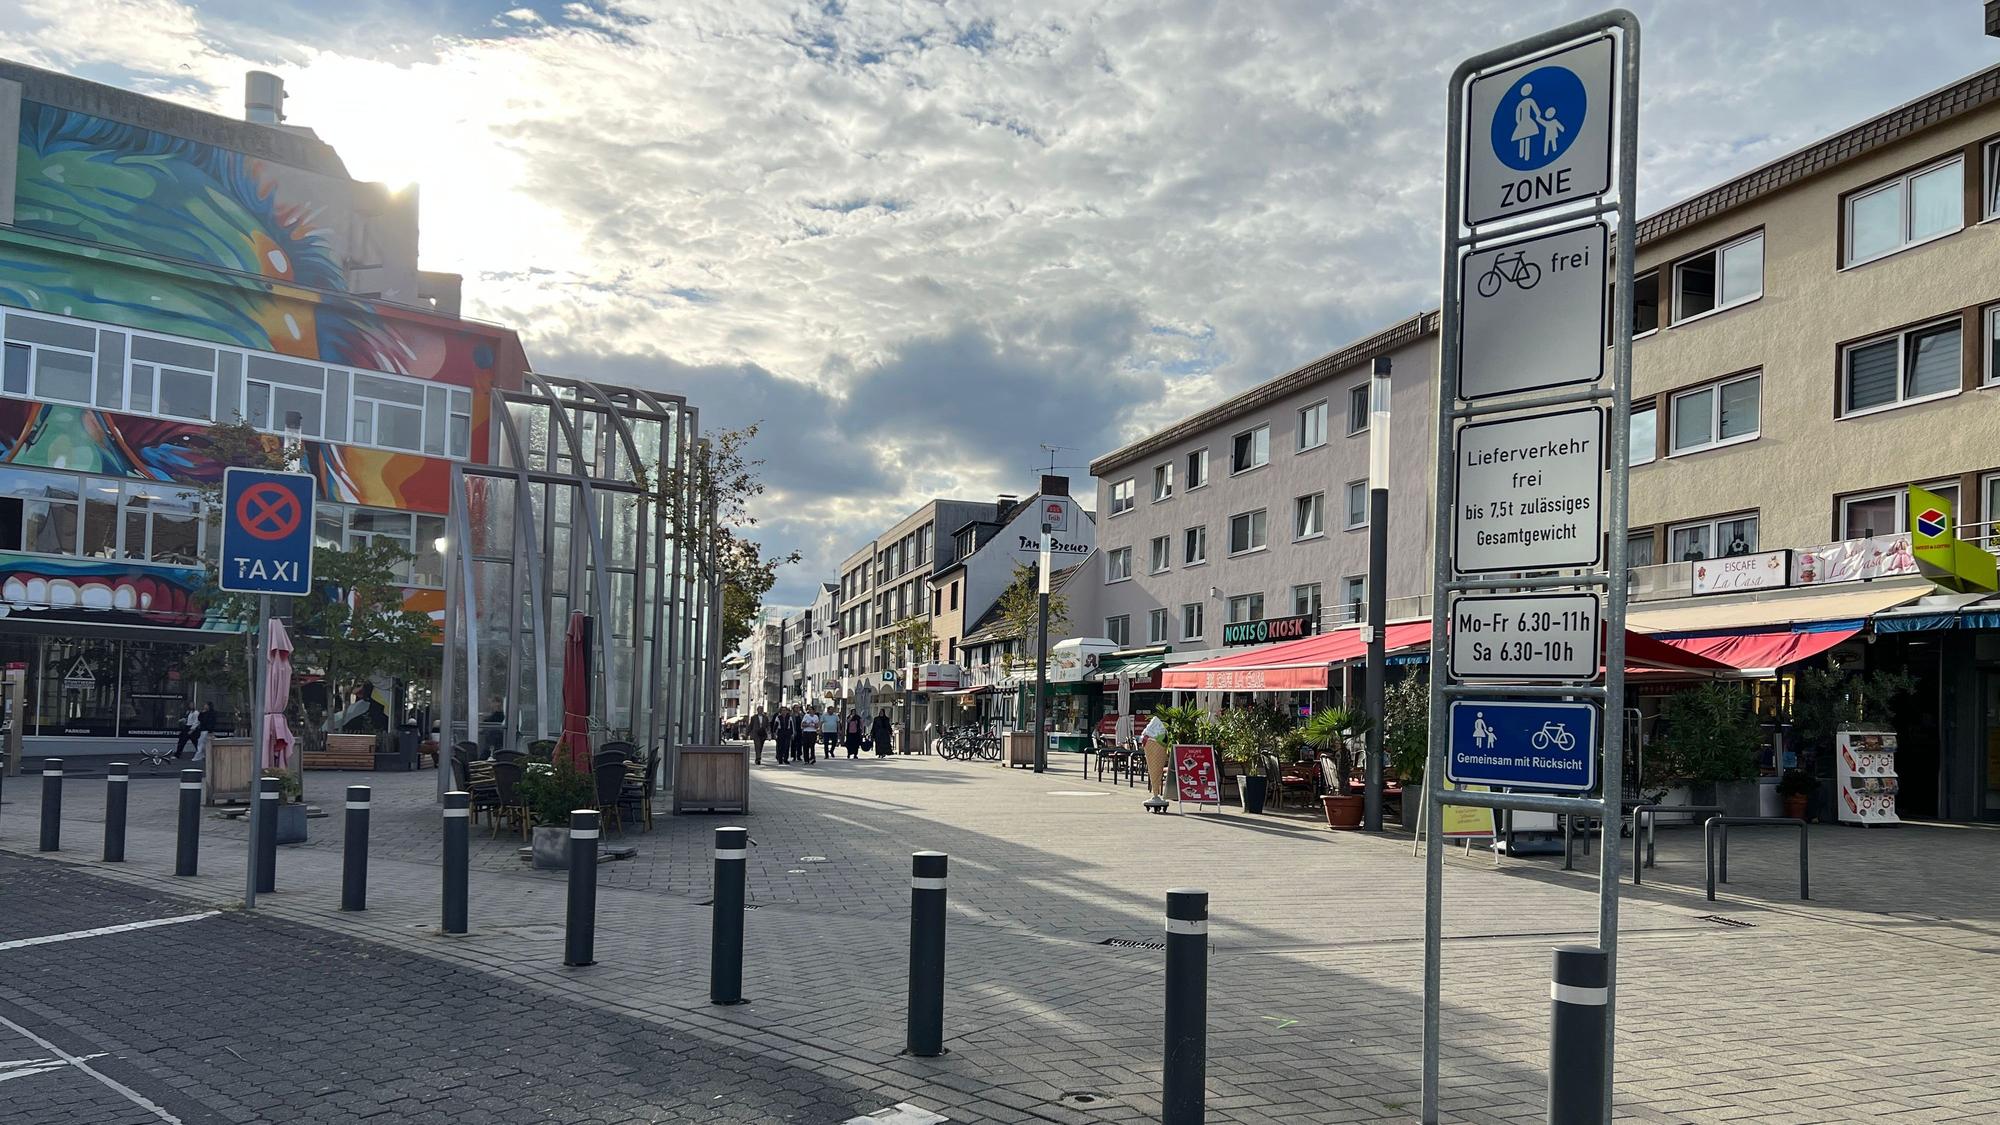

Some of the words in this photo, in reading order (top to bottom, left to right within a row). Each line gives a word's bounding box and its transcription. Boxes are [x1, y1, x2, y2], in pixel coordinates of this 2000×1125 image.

[1501, 168, 1572, 208] ZONE
[1551, 245, 1589, 273] frei
[1467, 438, 1590, 467] Lieferverkehr
[1512, 470, 1542, 489] frei
[1465, 504, 1484, 520] bis
[1520, 495, 1590, 515] zulässiges
[1477, 523, 1577, 547] Gesamtgewicht
[233, 557, 299, 582] TAXI
[1712, 573, 1731, 590] La
[1734, 572, 1763, 588] Casa
[1225, 624, 1256, 642] NOXIS
[1268, 618, 1303, 638] KIOSK
[1459, 613, 1510, 633] Mo-Fr
[1517, 611, 1590, 632] 6.30-11h
[1472, 642, 1492, 661] Sa
[1457, 752, 1512, 767] Gemeinsam
[1514, 755, 1530, 768] mit
[1532, 756, 1583, 771] Rücksicht
